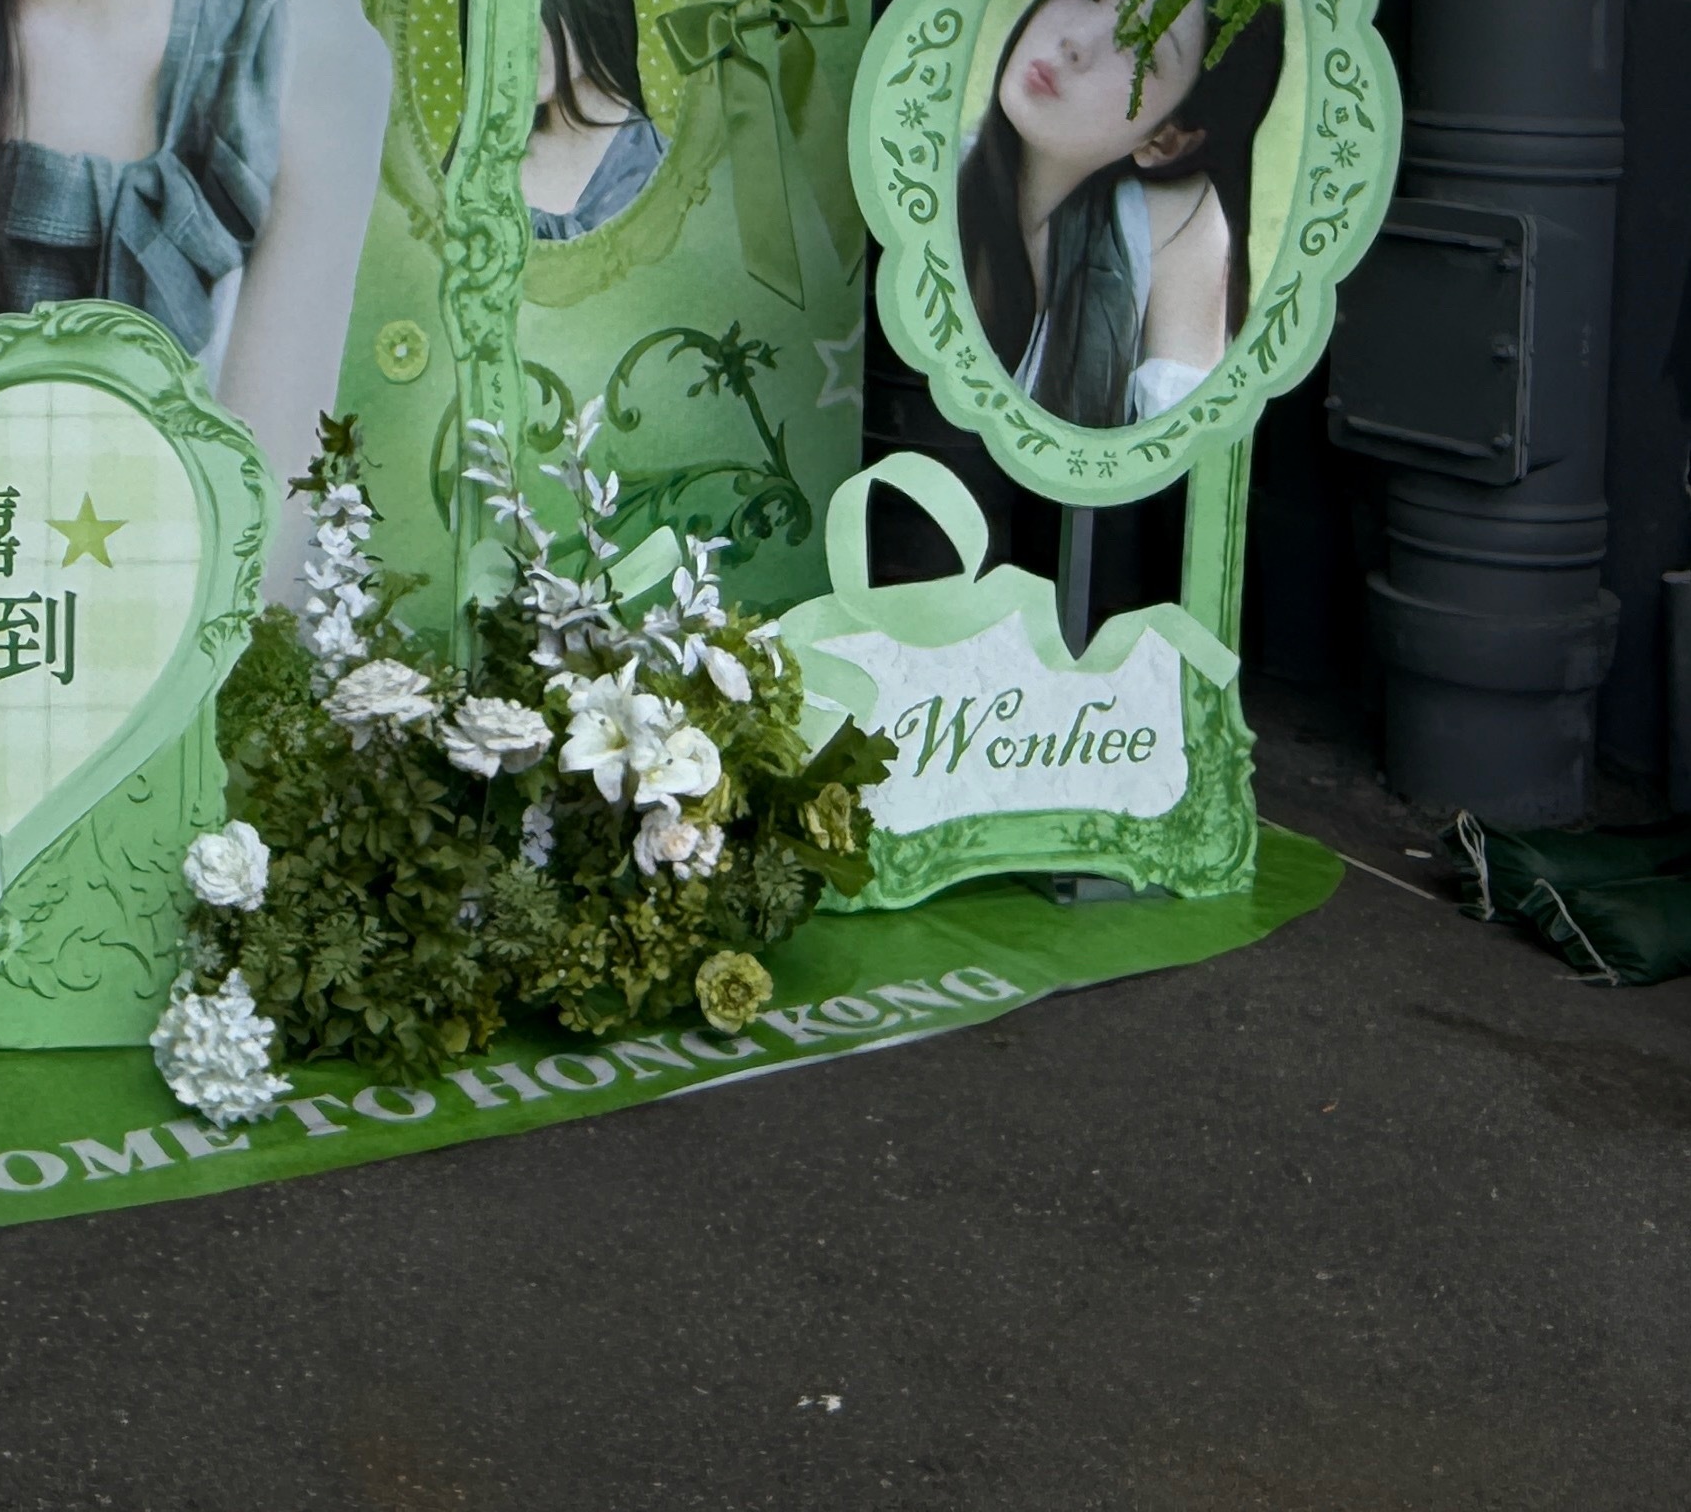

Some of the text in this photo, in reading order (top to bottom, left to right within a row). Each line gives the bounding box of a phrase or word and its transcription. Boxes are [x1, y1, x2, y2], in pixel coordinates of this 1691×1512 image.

[893, 687, 1157, 778] Wonhee
[274, 1085, 437, 1138] TO
[442, 1030, 768, 1112] HONG
[755, 966, 1026, 1045] KONG
